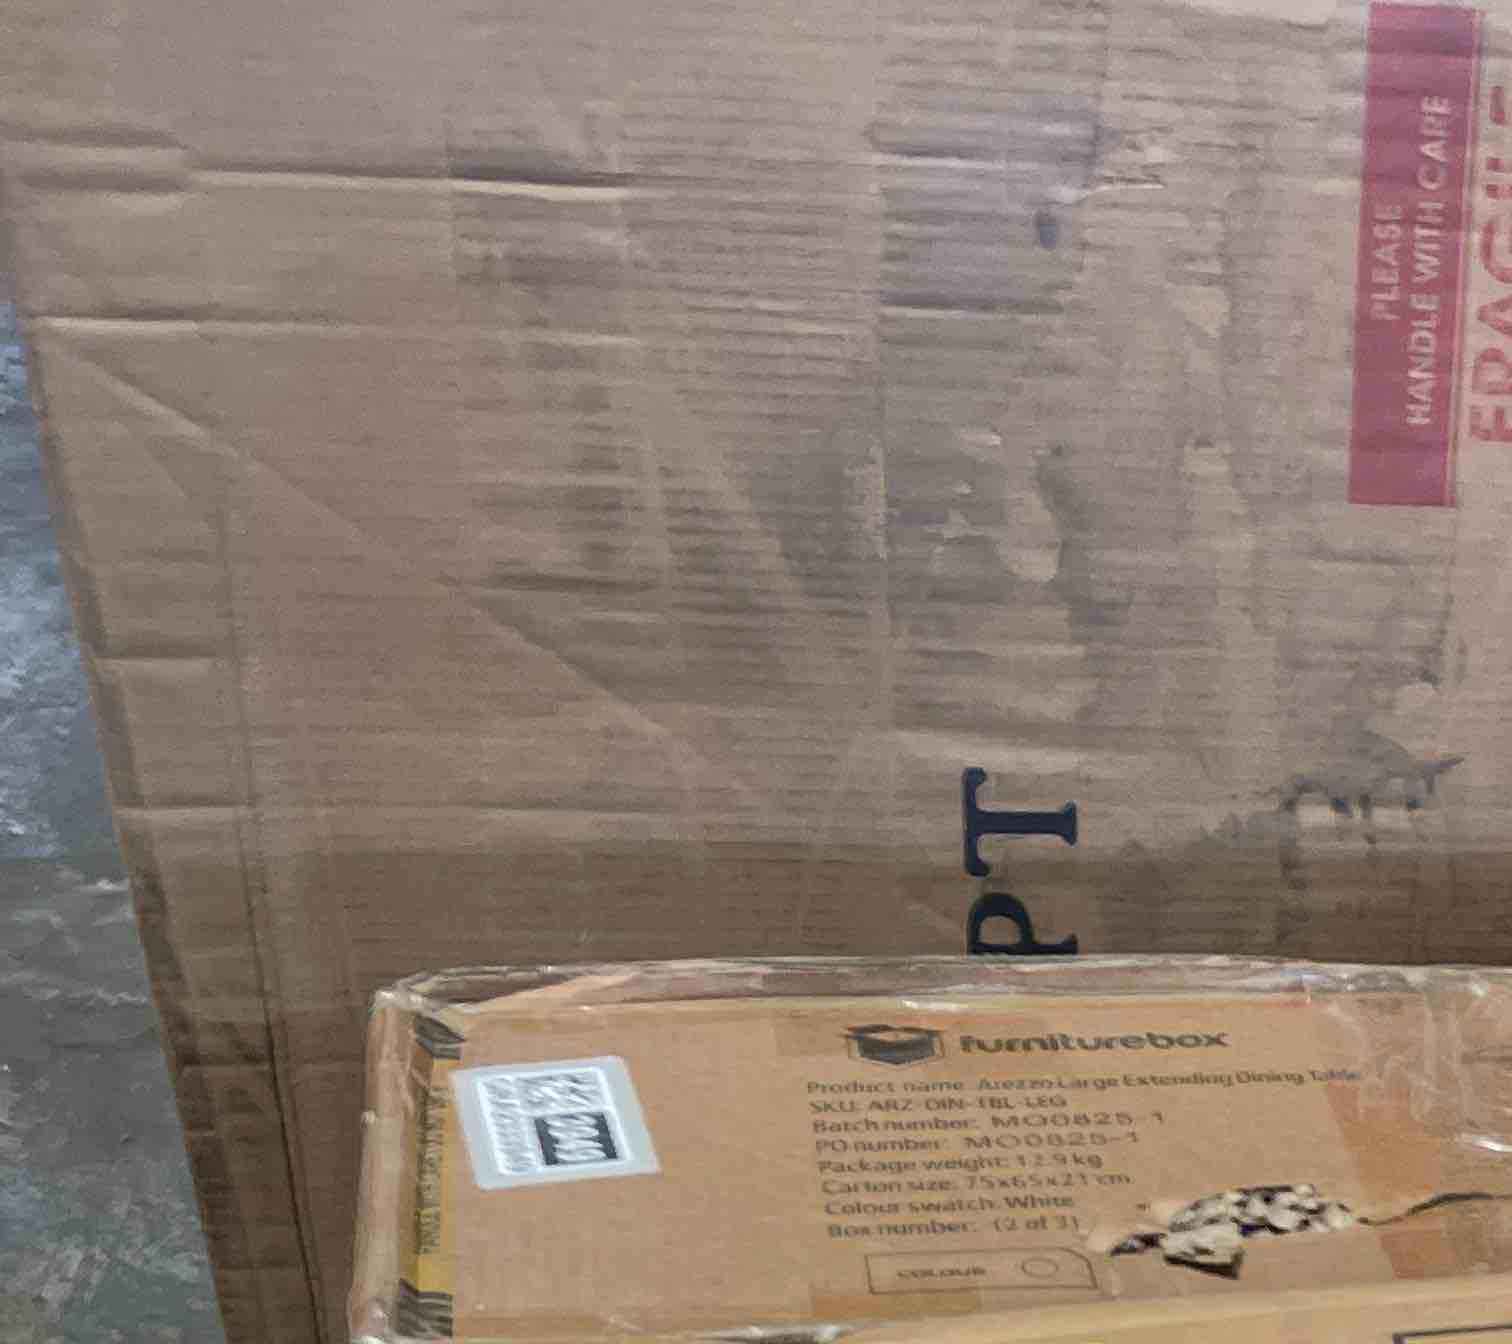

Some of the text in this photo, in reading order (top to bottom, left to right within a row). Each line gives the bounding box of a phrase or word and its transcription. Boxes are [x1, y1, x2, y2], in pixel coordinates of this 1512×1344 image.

[1370, 202, 1403, 321] PLEASE
[1406, 95, 1453, 425] HANDLE WITH CARE
[959, 1031, 1231, 1053] furniturebox
[807, 1080, 896, 1095] Product
[1122, 1071, 1234, 1087] Extending
[1235, 1069, 1305, 1085] Dining
[812, 1117, 878, 1134] Batch
[817, 1158, 917, 1175] Package
[821, 1179, 902, 1194] Carton
[823, 1201, 900, 1216] Colour
[1003, 1195, 1074, 1209] White
[827, 1223, 871, 1239] Box
